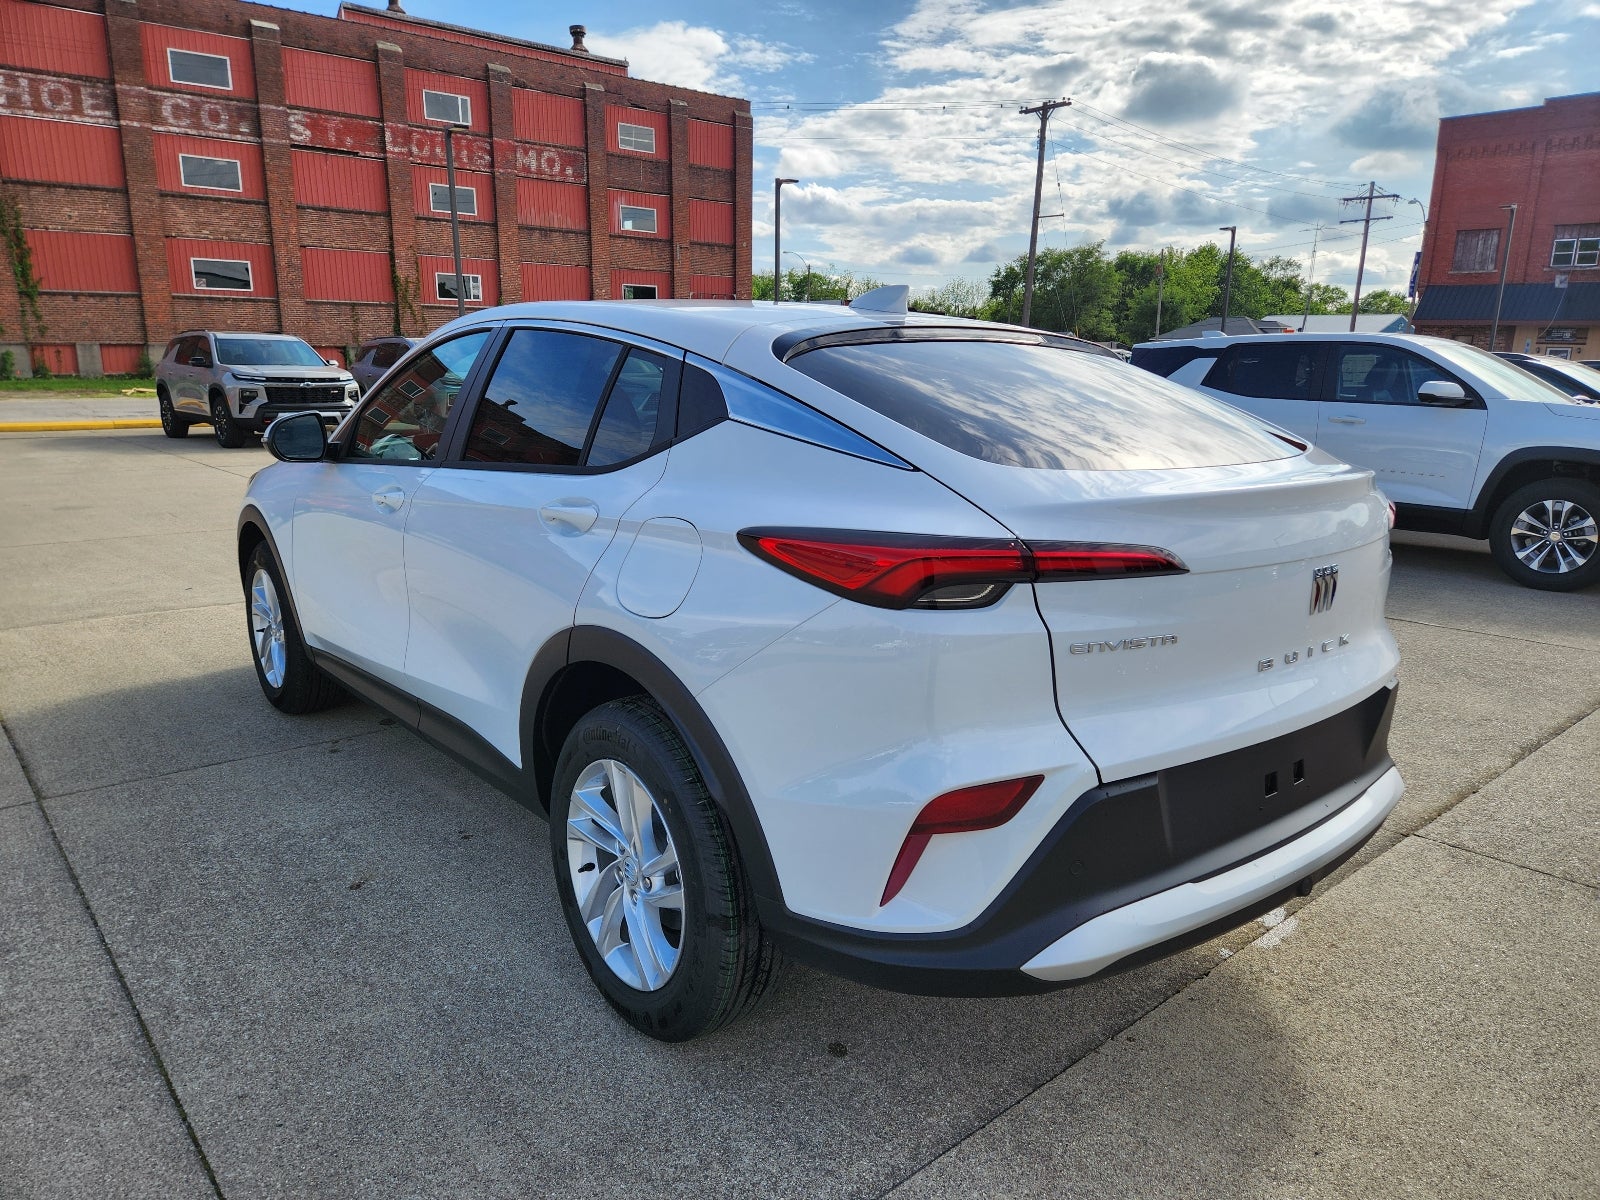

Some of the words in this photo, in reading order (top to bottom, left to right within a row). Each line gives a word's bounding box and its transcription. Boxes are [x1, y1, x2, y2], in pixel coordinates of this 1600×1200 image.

[162, 98, 250, 132] CO.
[516, 147, 574, 176] MO.
[1069, 633, 1178, 655] ENVISTA
[1257, 632, 1350, 673] BUICK
